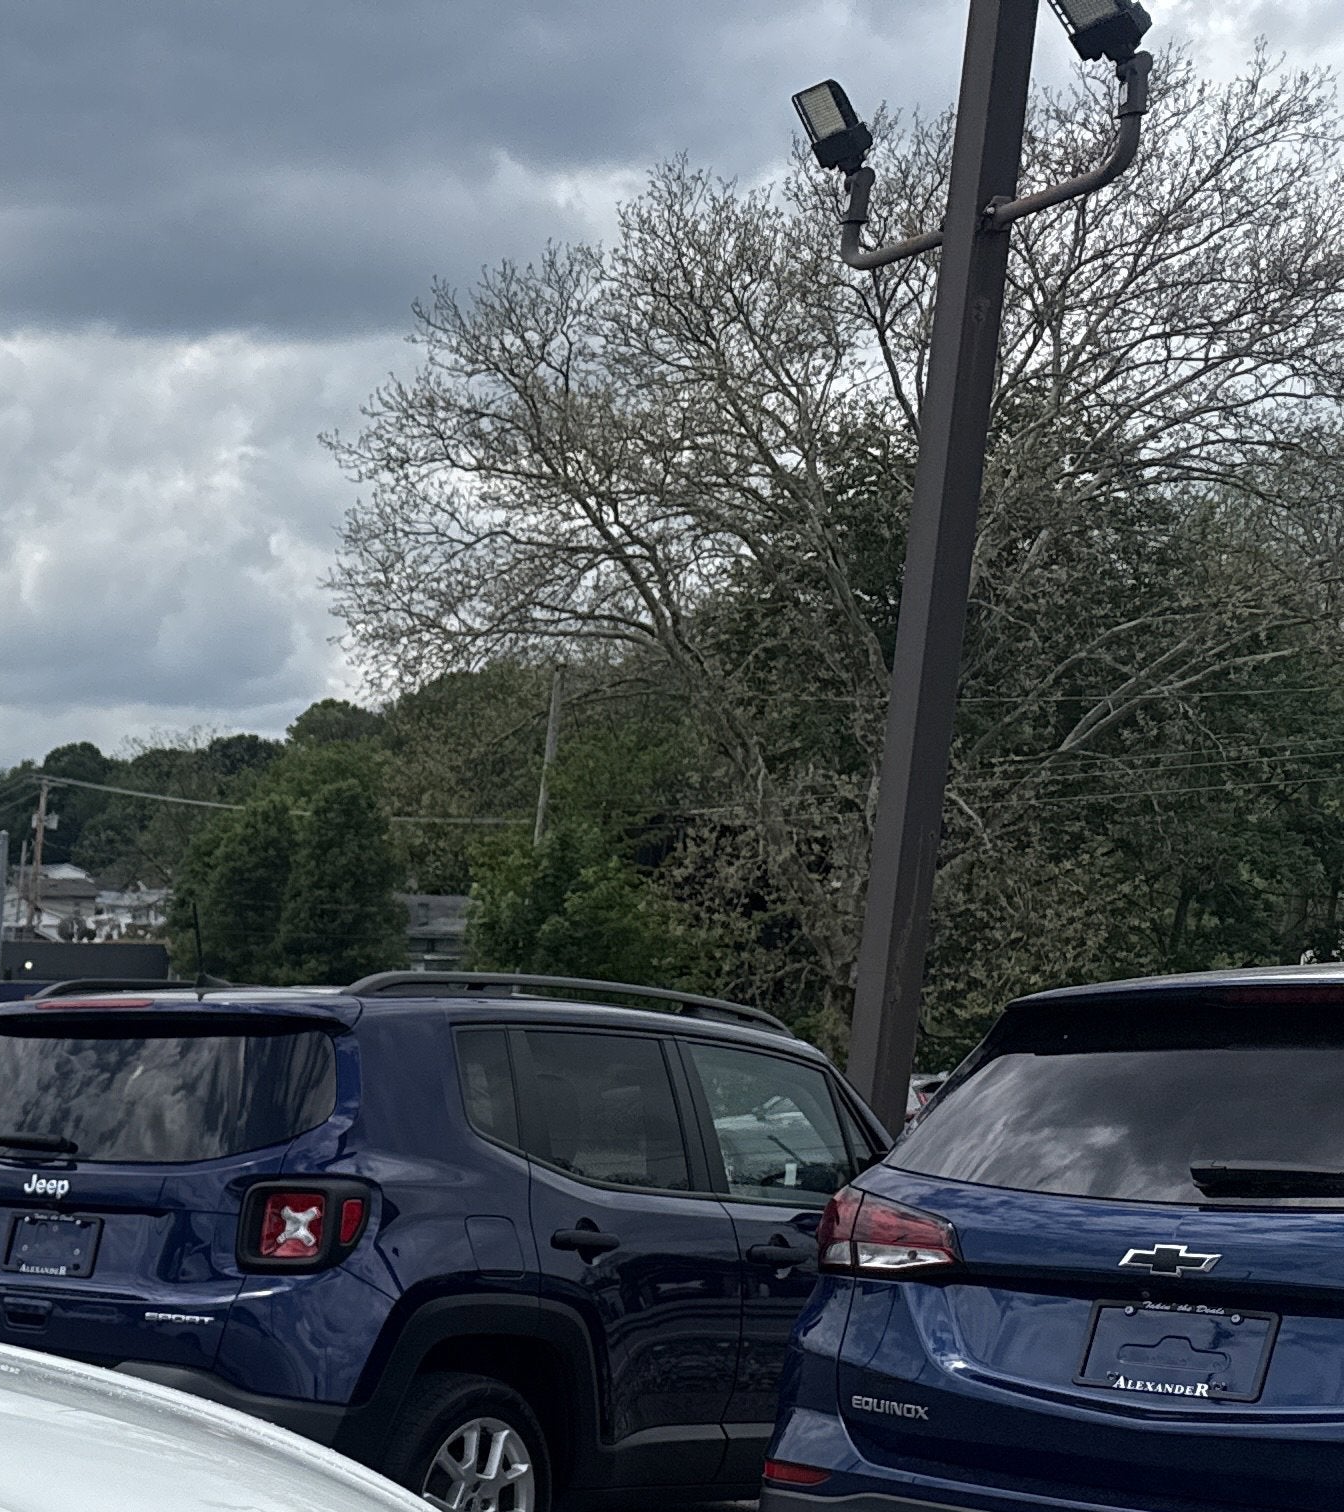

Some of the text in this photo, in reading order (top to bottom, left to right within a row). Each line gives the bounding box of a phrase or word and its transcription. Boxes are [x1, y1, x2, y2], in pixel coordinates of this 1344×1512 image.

[23, 1173, 70, 1200] Jeep
[20, 1263, 67, 1276] ALEXANDER
[144, 1312, 215, 1325] SPORT
[1113, 1375, 1209, 1397] ALEXANDER
[852, 1395, 929, 1421] EQUINOX
